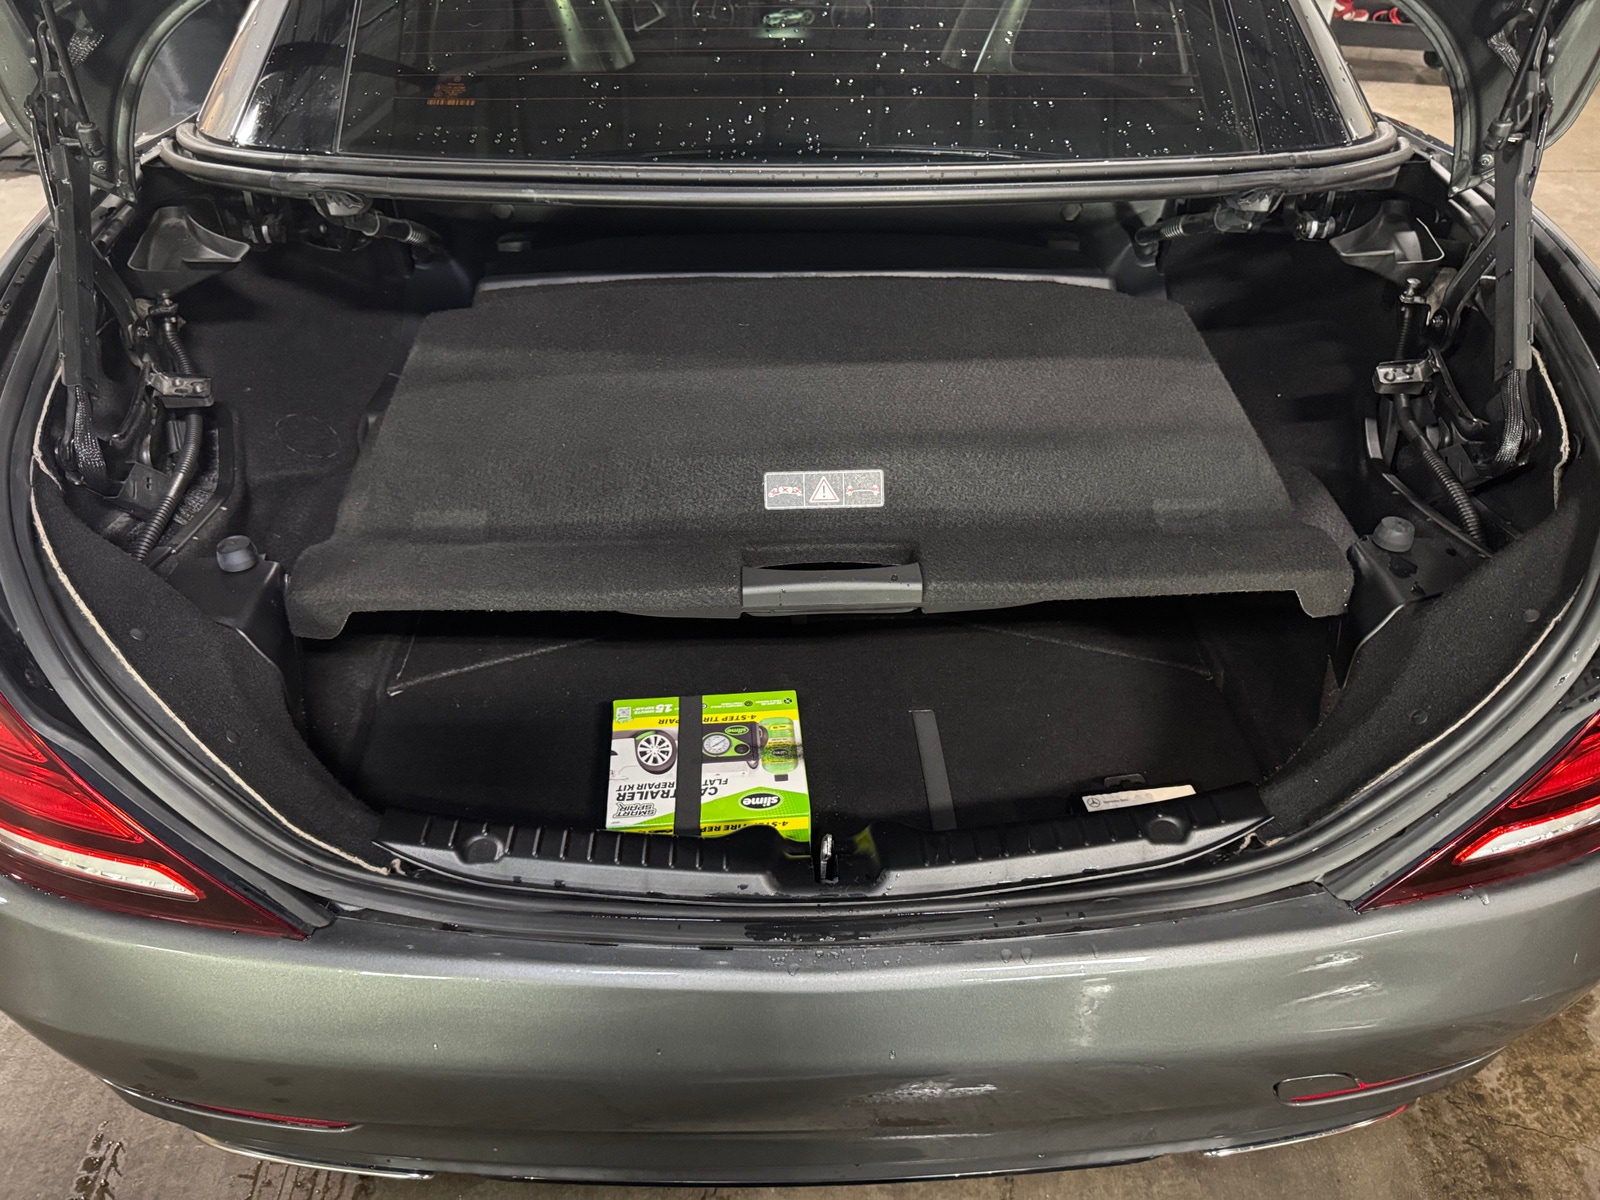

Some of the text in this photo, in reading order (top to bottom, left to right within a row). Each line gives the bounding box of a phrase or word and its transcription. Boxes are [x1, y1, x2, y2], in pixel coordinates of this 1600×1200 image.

[654, 703, 674, 713] 15
[721, 714, 757, 722] 4-STEP
[615, 778, 729, 792] FLAT REPAIR KIT
[616, 789, 677, 802] TRAILER
[742, 796, 779, 807] slime
[615, 809, 655, 817] SMART
